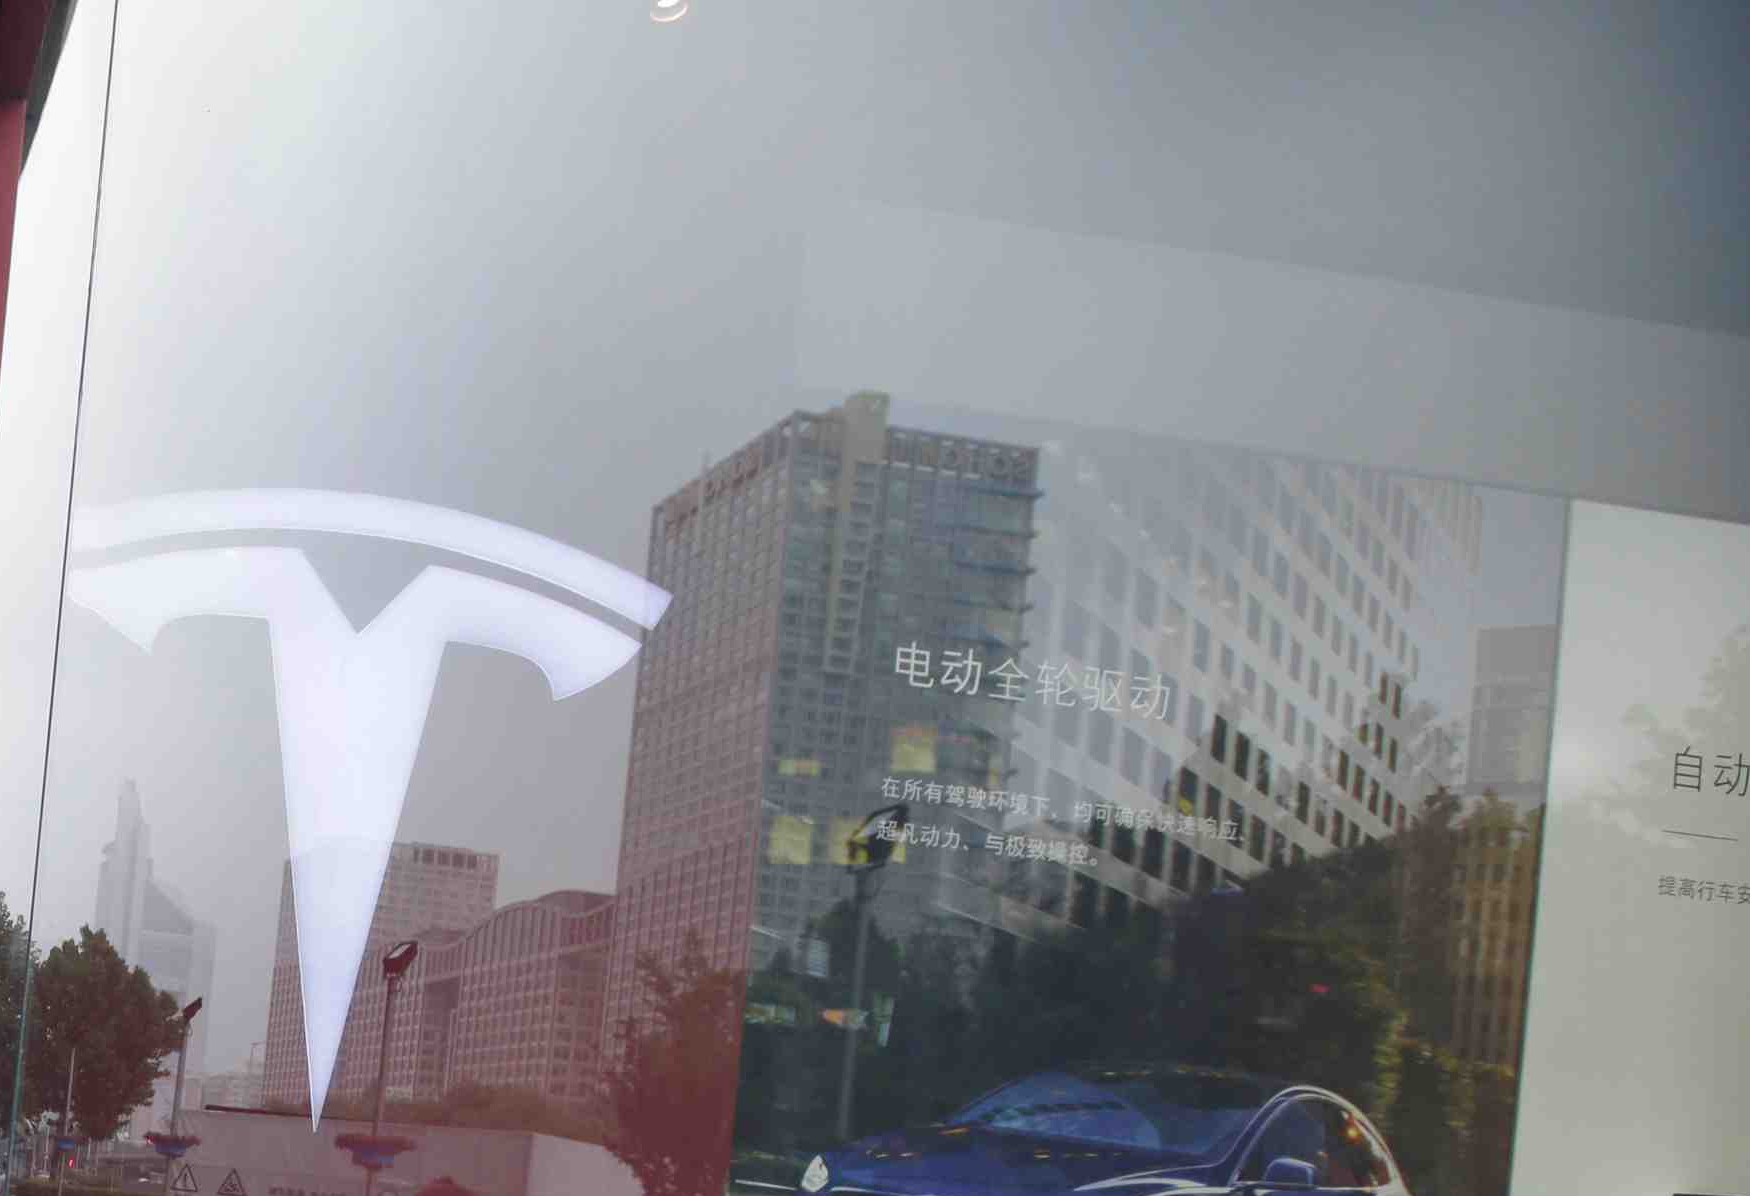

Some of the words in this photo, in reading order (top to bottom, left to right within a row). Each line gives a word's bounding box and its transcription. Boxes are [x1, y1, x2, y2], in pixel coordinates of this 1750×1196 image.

[893, 640, 1171, 721] 电动全轮驱动
[1673, 745, 1750, 798] 自动
